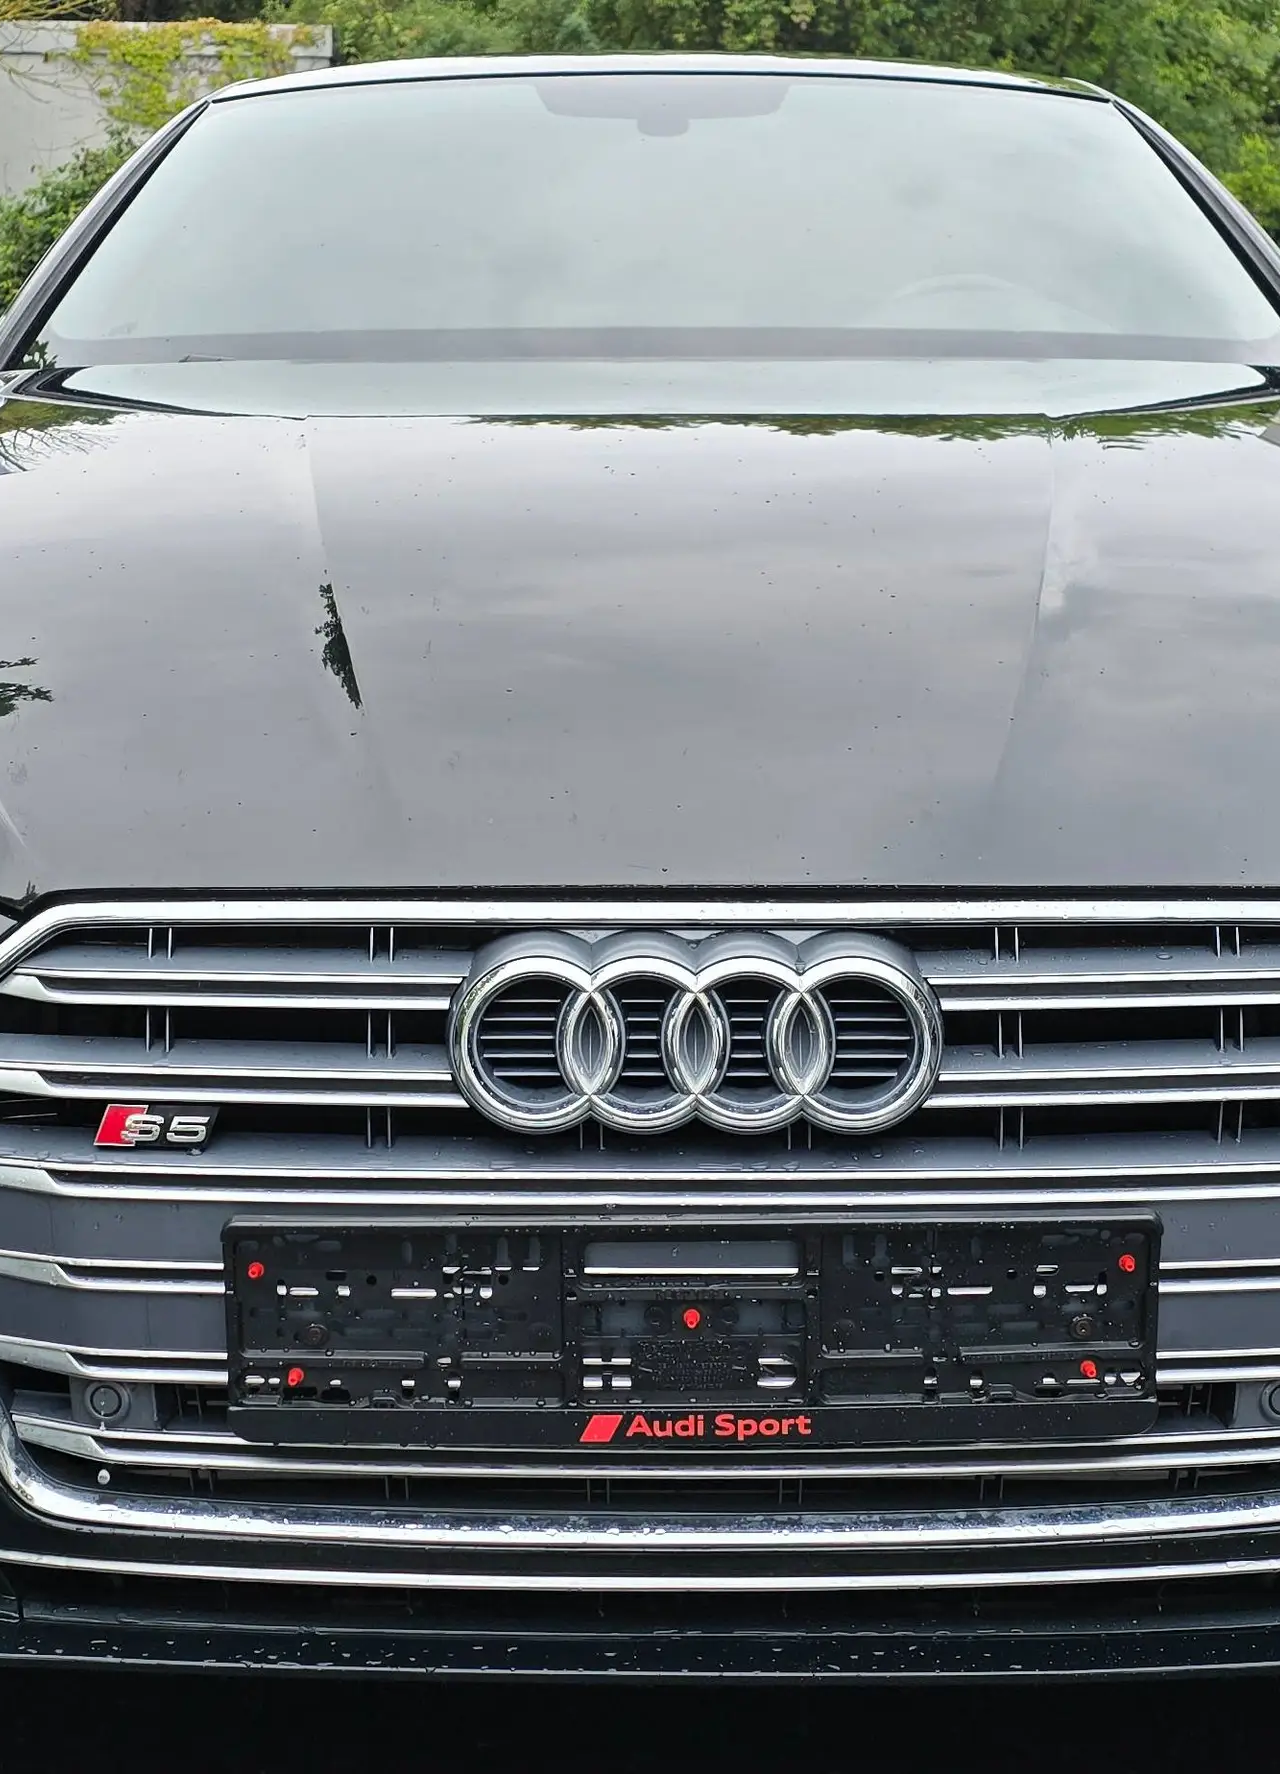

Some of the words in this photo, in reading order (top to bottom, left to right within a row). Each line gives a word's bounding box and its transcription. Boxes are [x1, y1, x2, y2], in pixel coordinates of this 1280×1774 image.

[121, 1113, 211, 1143] S5
[626, 1414, 705, 1438] Audi
[714, 1413, 812, 1441] Sport
